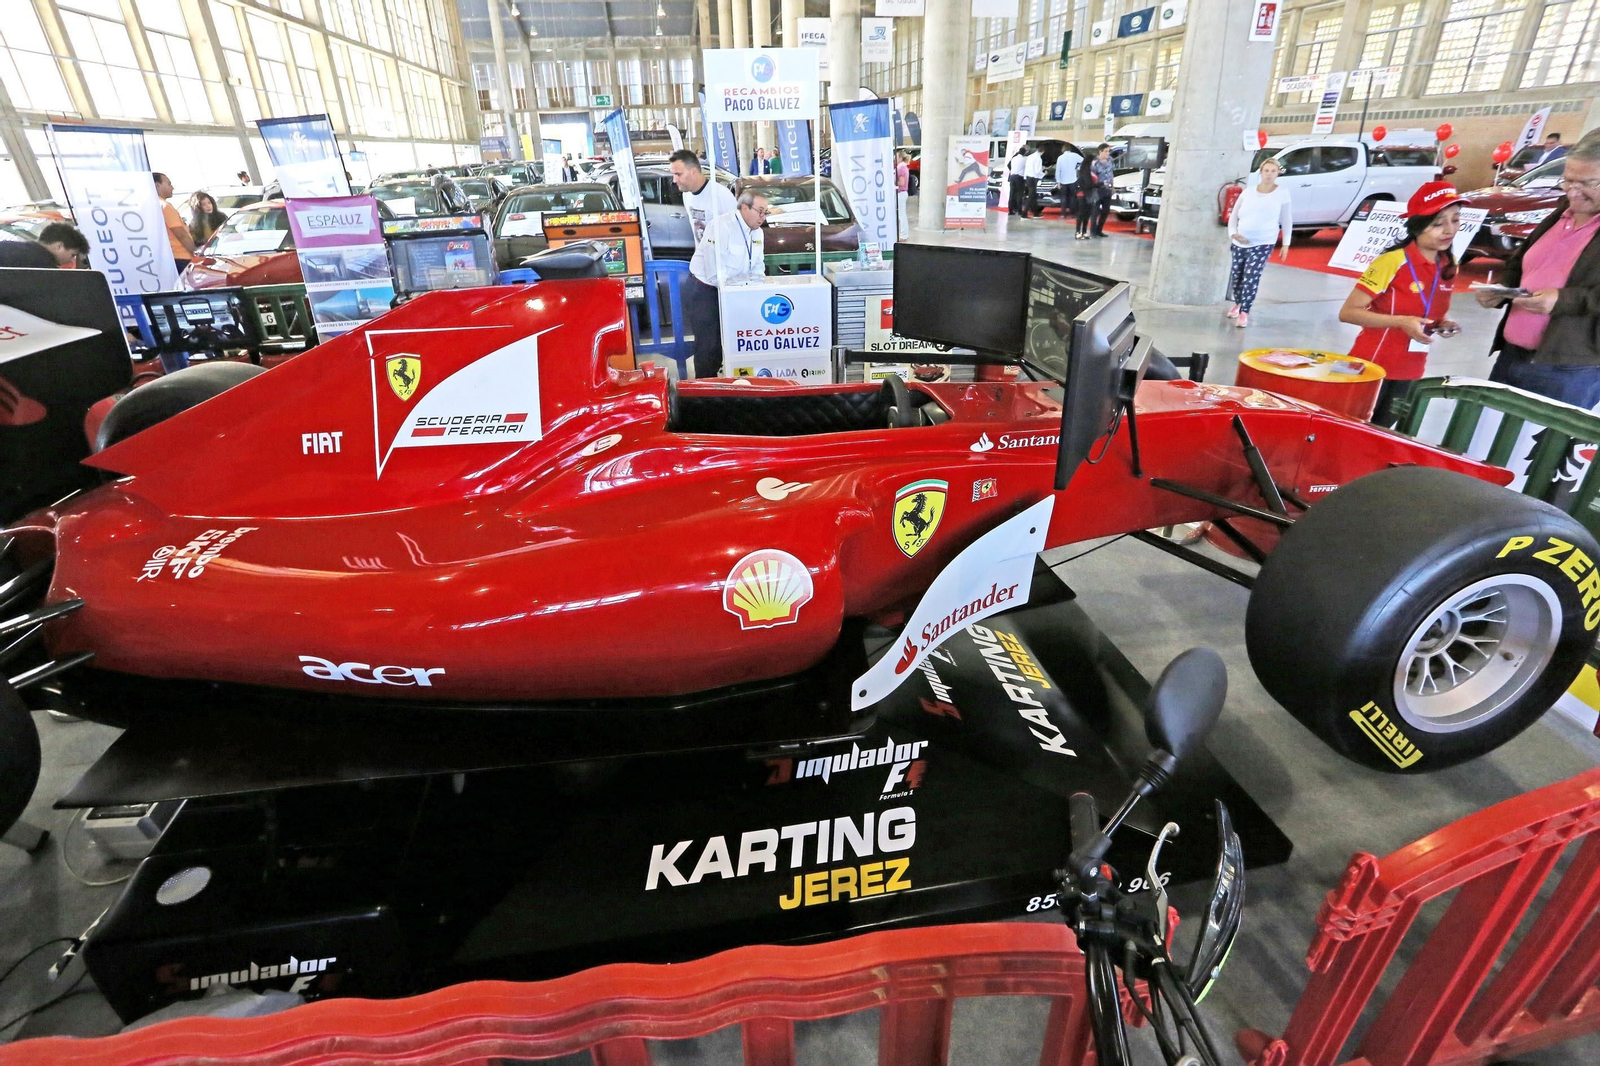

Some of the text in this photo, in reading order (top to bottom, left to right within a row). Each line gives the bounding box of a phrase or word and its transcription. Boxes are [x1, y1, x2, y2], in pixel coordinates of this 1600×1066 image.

[724, 86, 800, 96] RECAMBIOS
[725, 96, 800, 111] PACO GALVEZ
[307, 213, 364, 228] ESPALUZ
[1370, 212, 1399, 224] OFERTA
[1367, 226, 1387, 235] SOLO
[737, 326, 820, 338] RECAMBIOS
[737, 336, 820, 352] PACO GALVEZ
[871, 342, 897, 351] SLOT
[415, 414, 503, 426] SCUDERIA
[447, 424, 524, 435] FERRARI
[301, 431, 343, 455] FIAT
[168, 529, 228, 579] SKF
[188, 527, 259, 579] brembo
[1495, 536, 1600, 631] P ZERO
[921, 583, 1018, 652] Santander
[994, 630, 1051, 689] JEREZ
[299, 655, 445, 687] acer
[965, 623, 1078, 758] KARTING
[1349, 700, 1424, 769] PIRELLI
[879, 790, 908, 800] Formula
[645, 807, 917, 891] KARTING
[779, 857, 912, 910] JEREZ
[1026, 893, 1061, 912] 85
